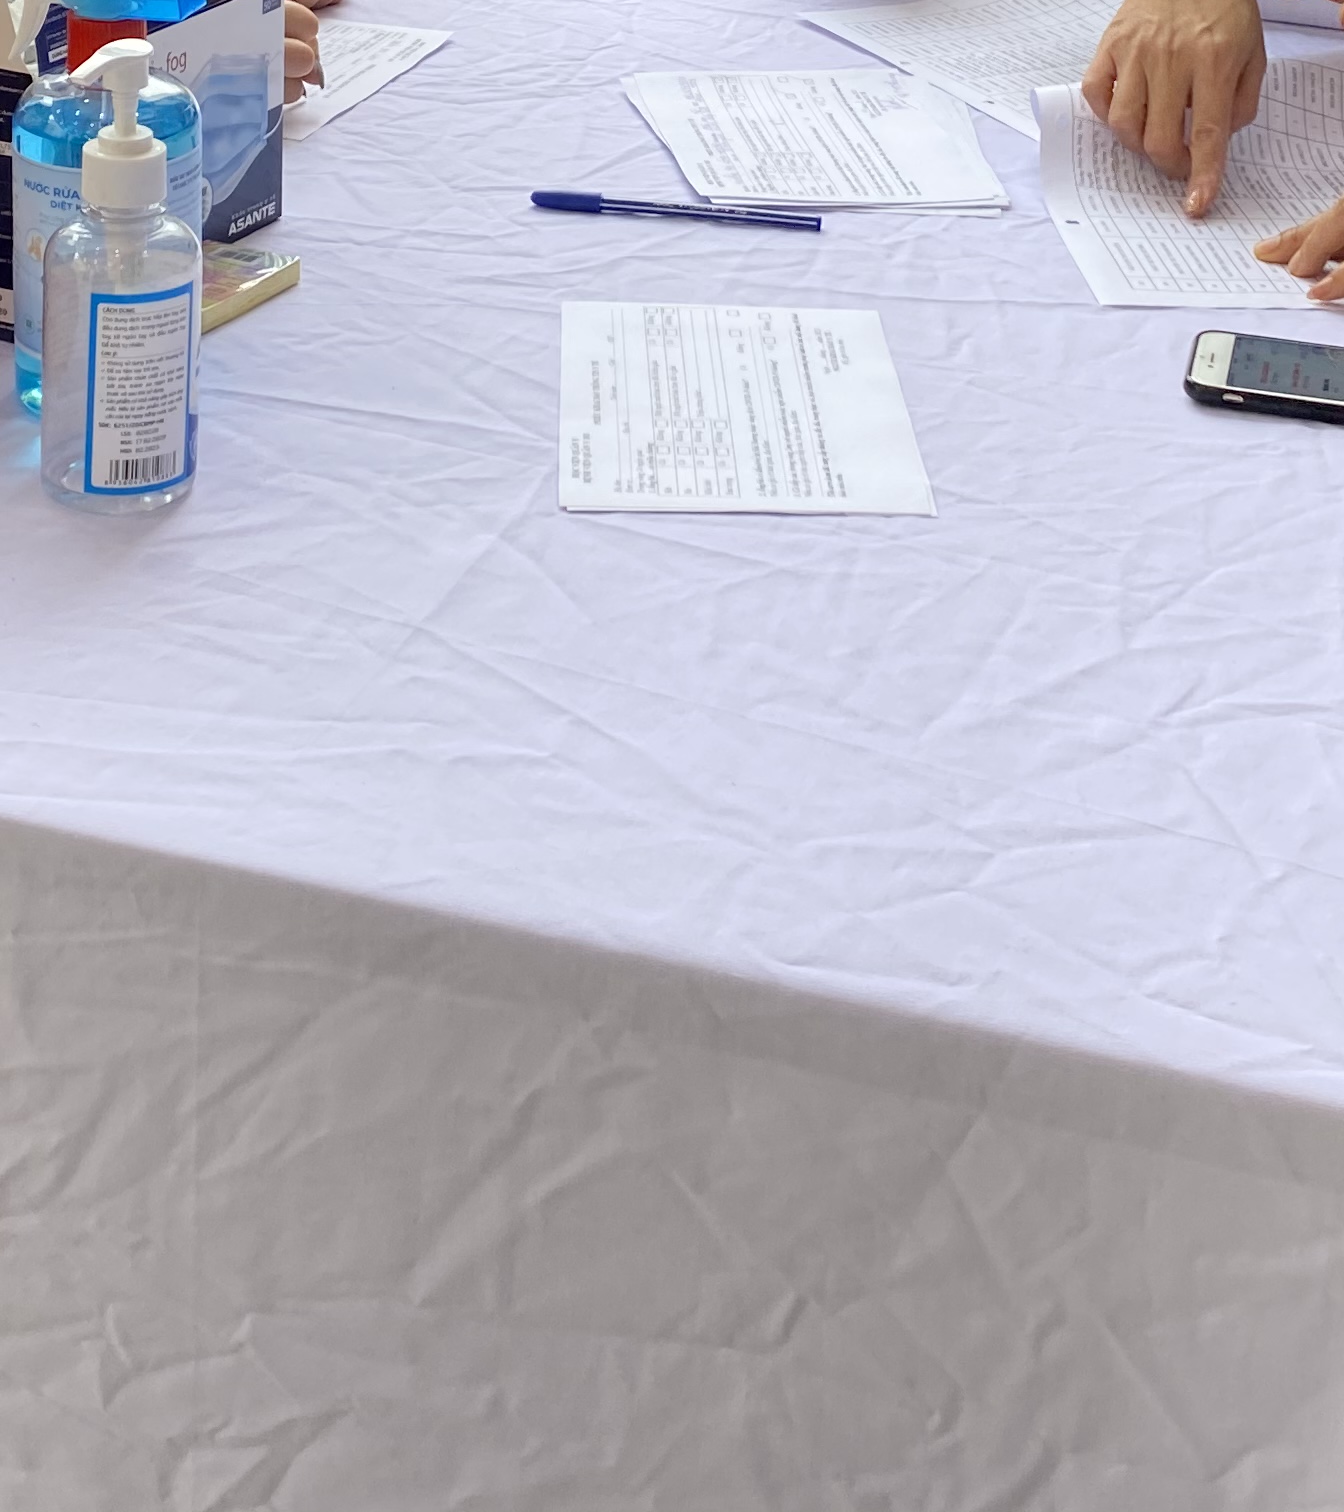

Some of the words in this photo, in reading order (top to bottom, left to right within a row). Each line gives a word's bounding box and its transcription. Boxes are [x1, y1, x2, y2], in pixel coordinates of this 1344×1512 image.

[166, 50, 187, 73] fog
[50, 200, 74, 212] DIỆT
[228, 201, 276, 238] ASANTE
